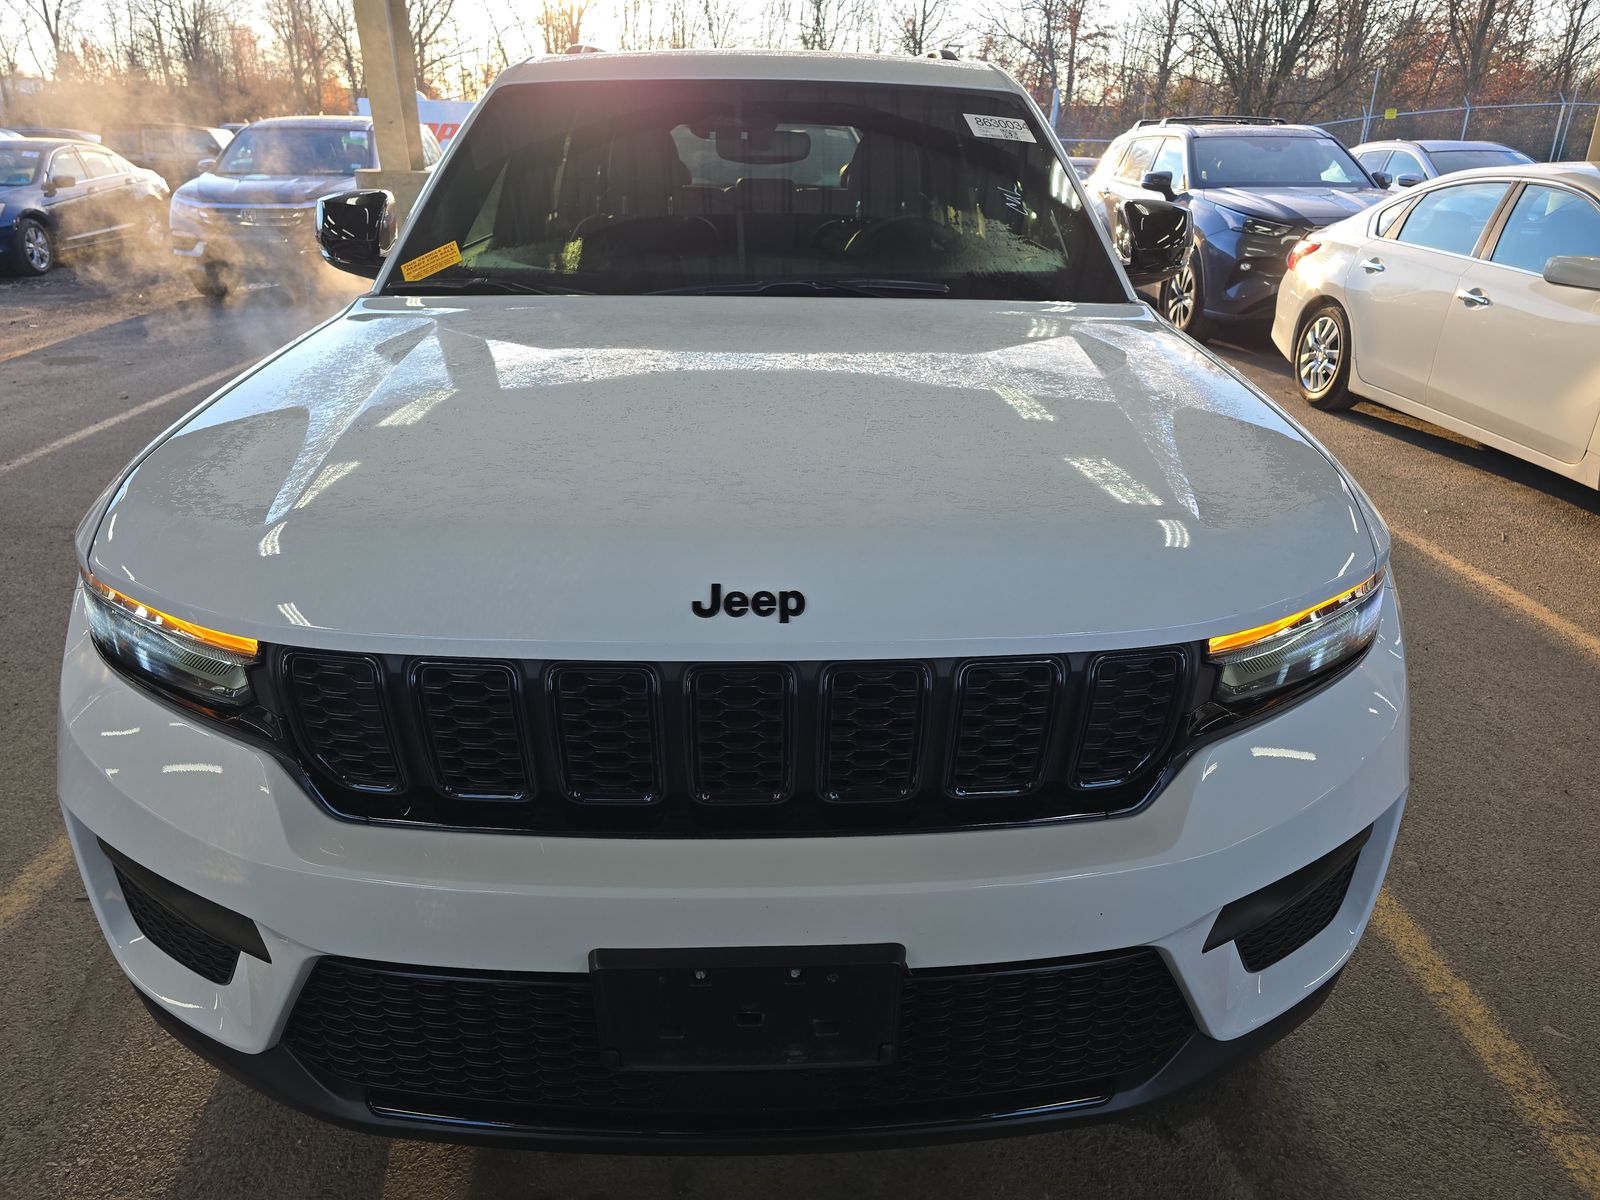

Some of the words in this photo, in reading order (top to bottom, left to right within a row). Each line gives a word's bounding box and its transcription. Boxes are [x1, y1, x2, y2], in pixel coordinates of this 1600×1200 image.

[403, 260, 417, 269] THIS
[418, 249, 442, 262] VEHICLE
[443, 243, 455, 251] NOT
[406, 261, 425, 272] READY
[426, 254, 439, 263] FOR
[440, 247, 454, 256] SALE
[691, 583, 805, 624] Jeep
